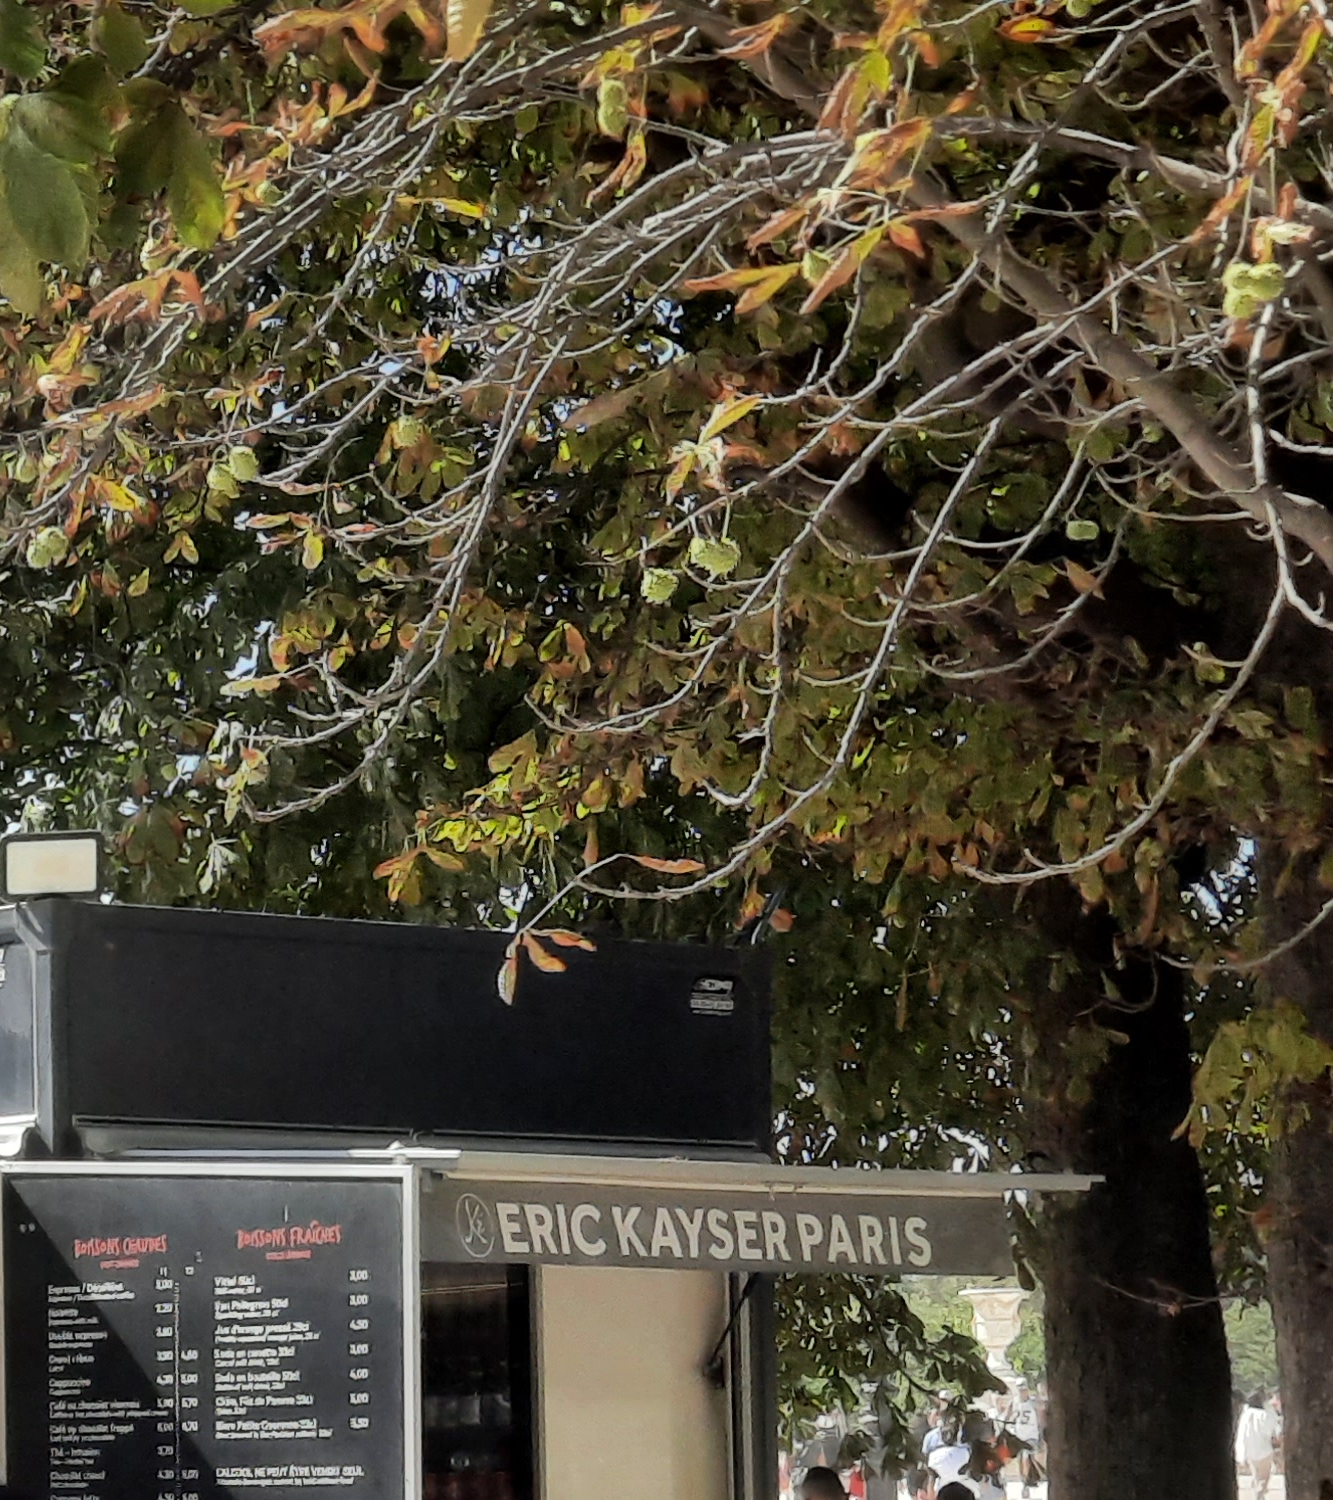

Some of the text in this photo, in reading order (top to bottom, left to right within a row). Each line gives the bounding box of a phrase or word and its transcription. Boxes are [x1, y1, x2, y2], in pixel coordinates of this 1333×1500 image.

[495, 1201, 935, 1268] ERIC KAYSER PARIS
